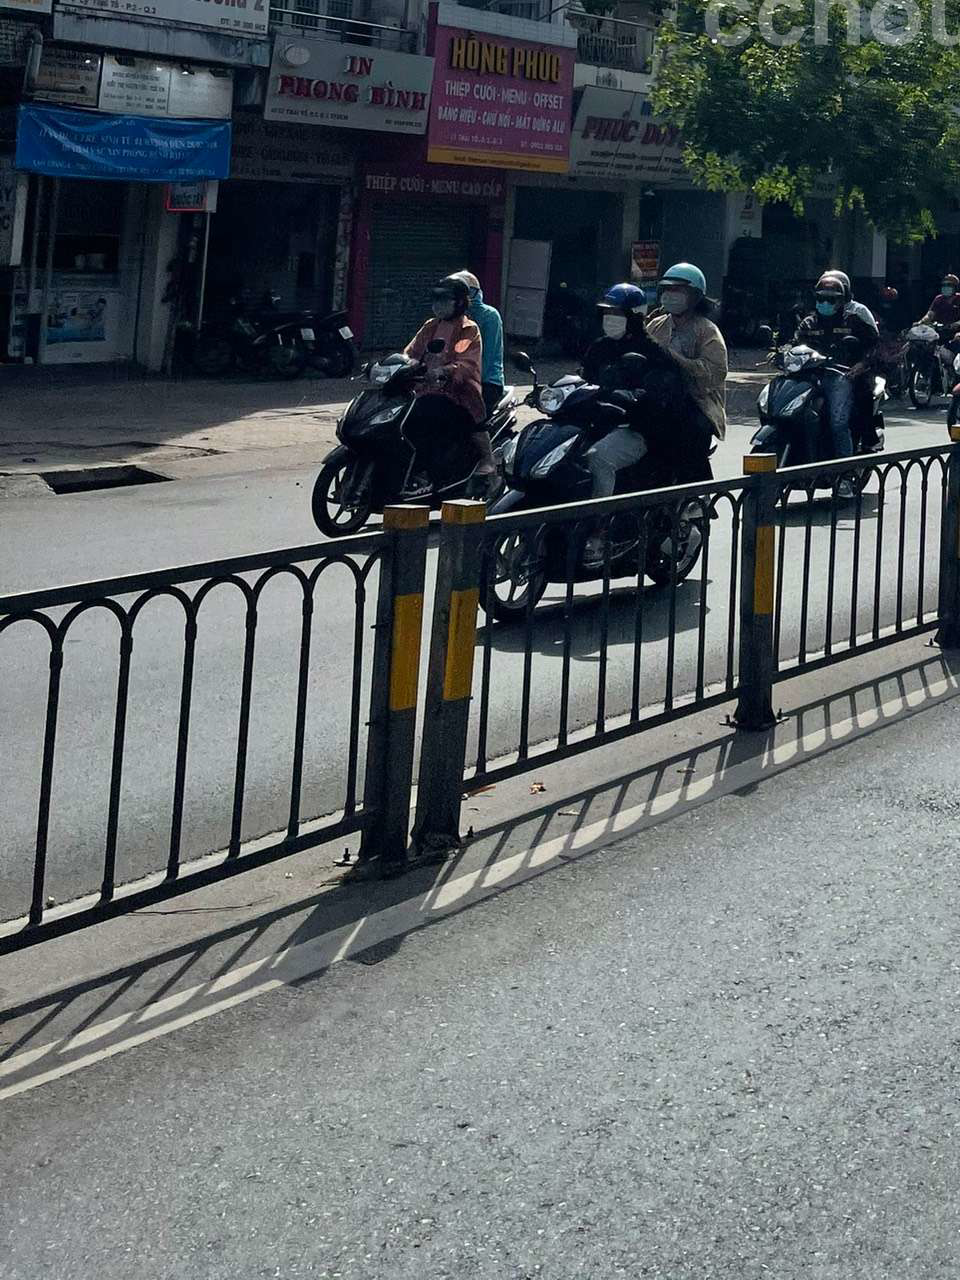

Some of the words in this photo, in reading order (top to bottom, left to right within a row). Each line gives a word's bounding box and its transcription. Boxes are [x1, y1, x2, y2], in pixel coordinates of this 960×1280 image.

[343, 55, 373, 76] IN
[450, 31, 508, 76] HỒNG
[511, 45, 560, 83] PHÚC
[277, 74, 360, 104] PHONG
[367, 79, 428, 111] BÌNH
[445, 79, 471, 100] THIỆP
[473, 81, 497, 101] CƯỚI
[502, 88, 527, 105] MENU
[533, 92, 564, 110] OFFSET
[581, 111, 640, 142] PHÚC
[366, 172, 397, 194] THIỆP
[400, 173, 424, 192] CƯỚI
[432, 179, 460, 194] MENU
